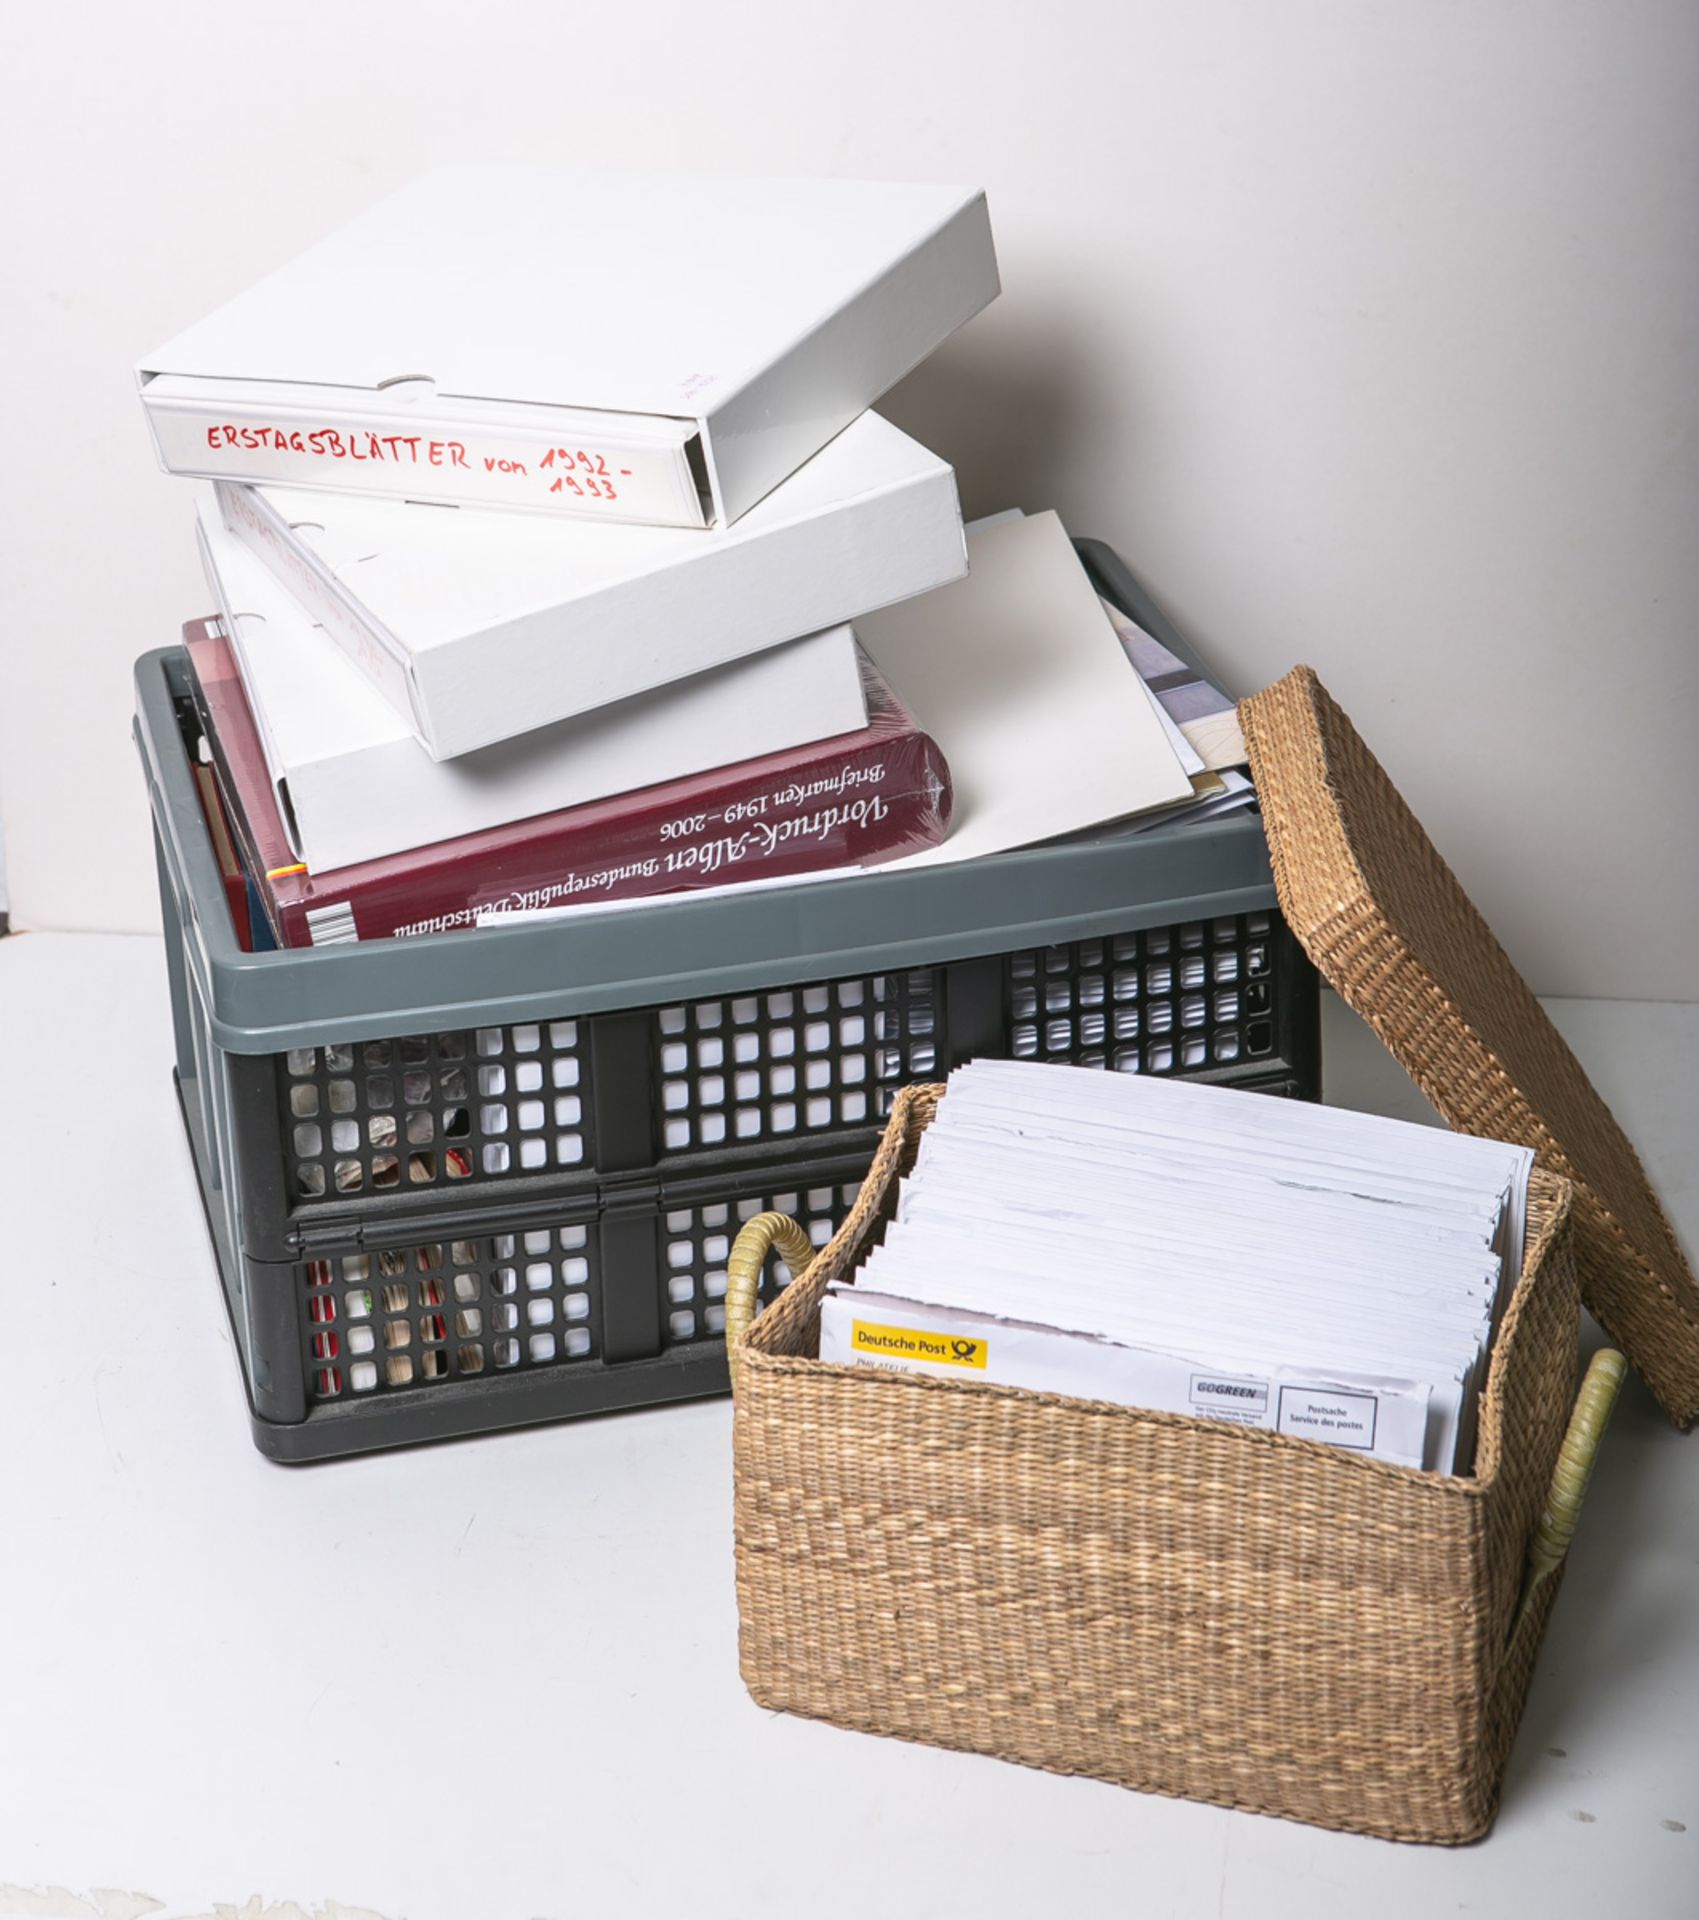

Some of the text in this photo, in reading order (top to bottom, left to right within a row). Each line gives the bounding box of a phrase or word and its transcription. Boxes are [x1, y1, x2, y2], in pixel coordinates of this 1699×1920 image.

[207, 425, 470, 469] ERSTAGSBLÄTTER
[484, 457, 528, 477] von
[550, 476, 618, 500] 1993
[773, 763, 886, 807] Briefmarken
[664, 795, 889, 875] Vordruck-Alben
[511, 857, 660, 913] Bundesrepublik
[858, 1330, 947, 1356] Deutsche Post
[1197, 1382, 1257, 1399] GOGREEN
[1290, 1413, 1363, 1431] Service des postes
[1307, 1404, 1348, 1418] Postsache
